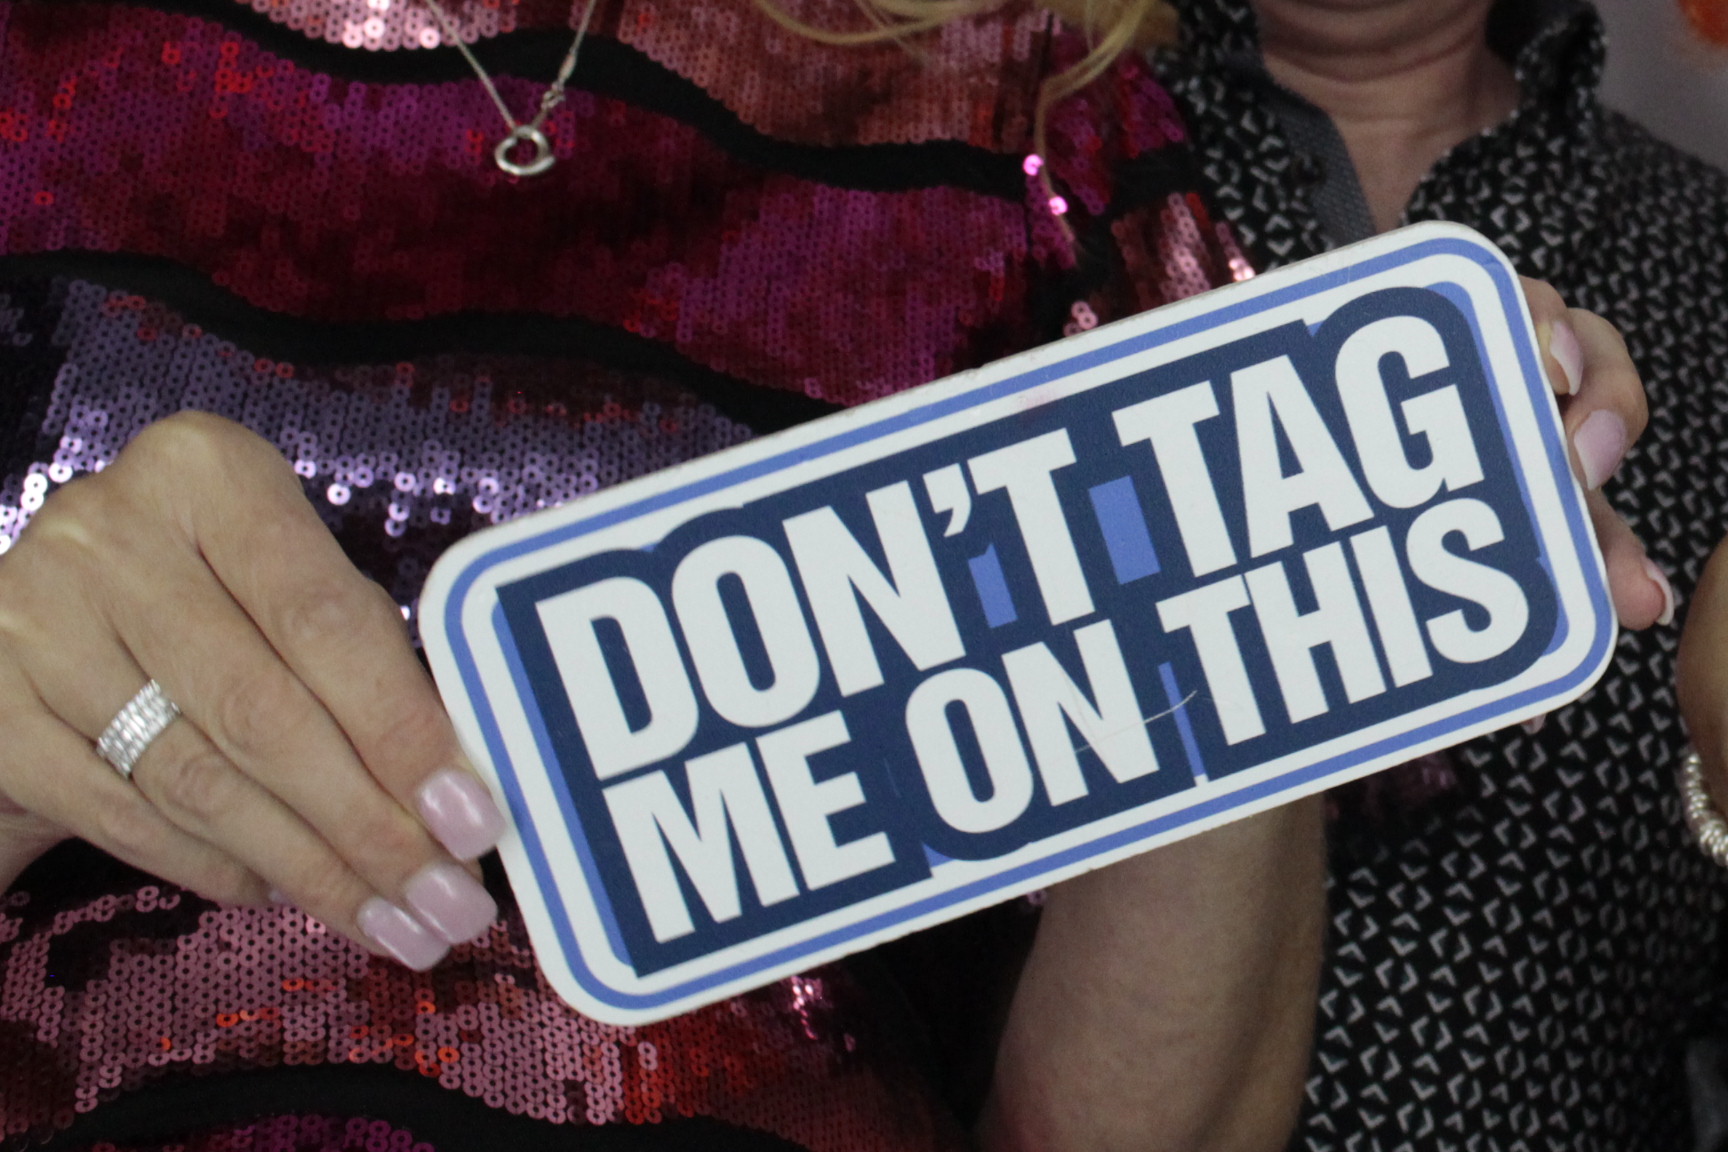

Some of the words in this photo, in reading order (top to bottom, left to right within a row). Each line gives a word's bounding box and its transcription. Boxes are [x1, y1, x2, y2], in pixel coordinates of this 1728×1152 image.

[536, 428, 1096, 780] DON'T
[1112, 315, 1484, 577] TAG
[602, 711, 895, 943] ME
[905, 619, 1159, 833] ON
[1156, 498, 1529, 746] THIS
